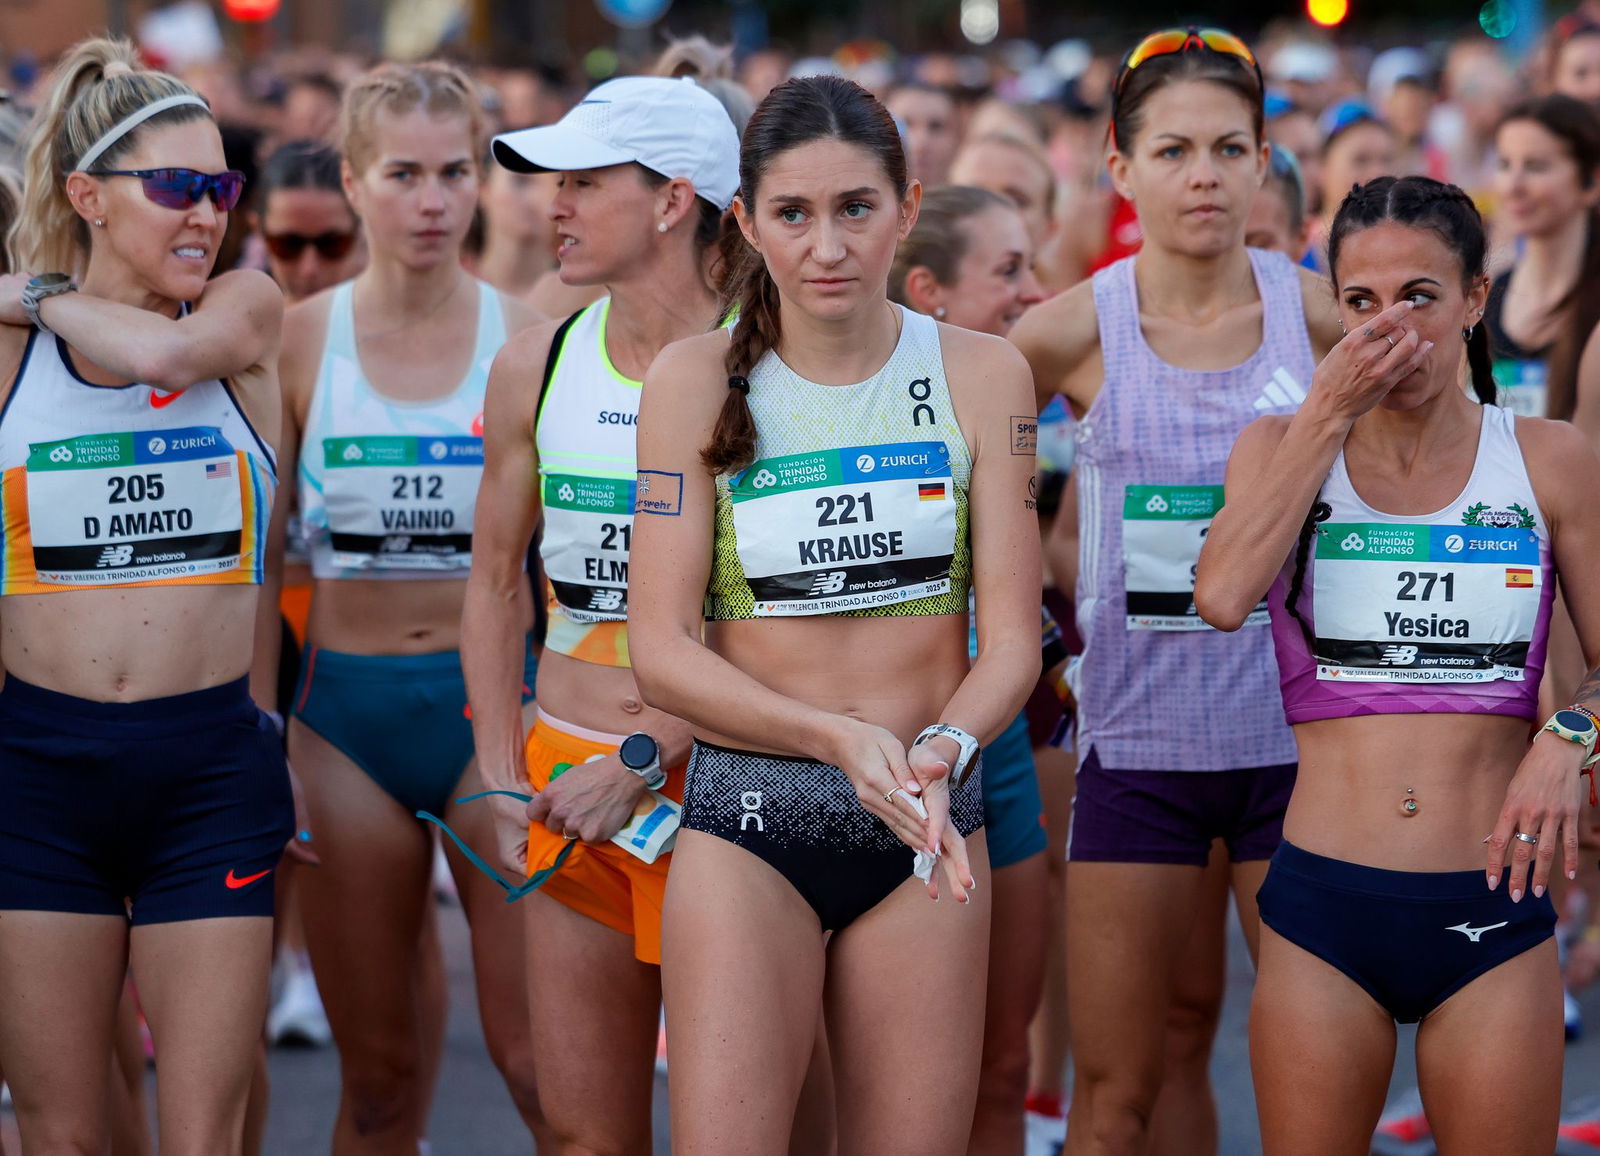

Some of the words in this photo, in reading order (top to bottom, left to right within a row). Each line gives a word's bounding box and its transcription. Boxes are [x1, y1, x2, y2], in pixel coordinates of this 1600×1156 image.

[76, 445, 120, 455] TRINIDAD
[171, 435, 216, 450] ZURICH
[77, 453, 120, 464] ALFONSO
[778, 457, 825, 468] FUNDACIÓN
[880, 453, 928, 468] ZURICH
[779, 464, 826, 478] TRINIDAD
[392, 475, 443, 499] 212
[577, 482, 615, 490] FUNDACIÓN
[780, 472, 828, 487] ALFONSO
[108, 473, 165, 504] 205
[577, 489, 615, 500] TRINIDAD
[577, 498, 615, 508] ALFONSO
[815, 492, 874, 528] 221
[83, 516, 100, 539] D
[108, 507, 193, 538] AMATO
[381, 509, 455, 529] VAINIO
[798, 530, 904, 566] KRAUSE
[1368, 537, 1415, 546] TRINIDAD
[1469, 540, 1517, 551] ZURICH
[136, 555, 154, 565] new
[153, 551, 186, 562] balance
[1367, 546, 1414, 555] ALFONSO
[74, 573, 105, 581] VALENCIA
[107, 570, 147, 581] TRINIDAD
[147, 565, 186, 577] ALFONSO
[584, 557, 628, 583] ELM
[808, 571, 847, 596] NB
[849, 582, 867, 591] new
[867, 577, 897, 588] balance
[1396, 571, 1455, 602] 271
[820, 597, 860, 610] TRINIDAD
[861, 591, 899, 605] ALFONSO
[925, 583, 941, 593] 2025
[1384, 611, 1470, 638] Yesica
[1378, 645, 1419, 666] NB
[1440, 657, 1475, 666] balance
[1389, 671, 1431, 680] TRINIDAD
[1431, 672, 1474, 680] ALFONSO
